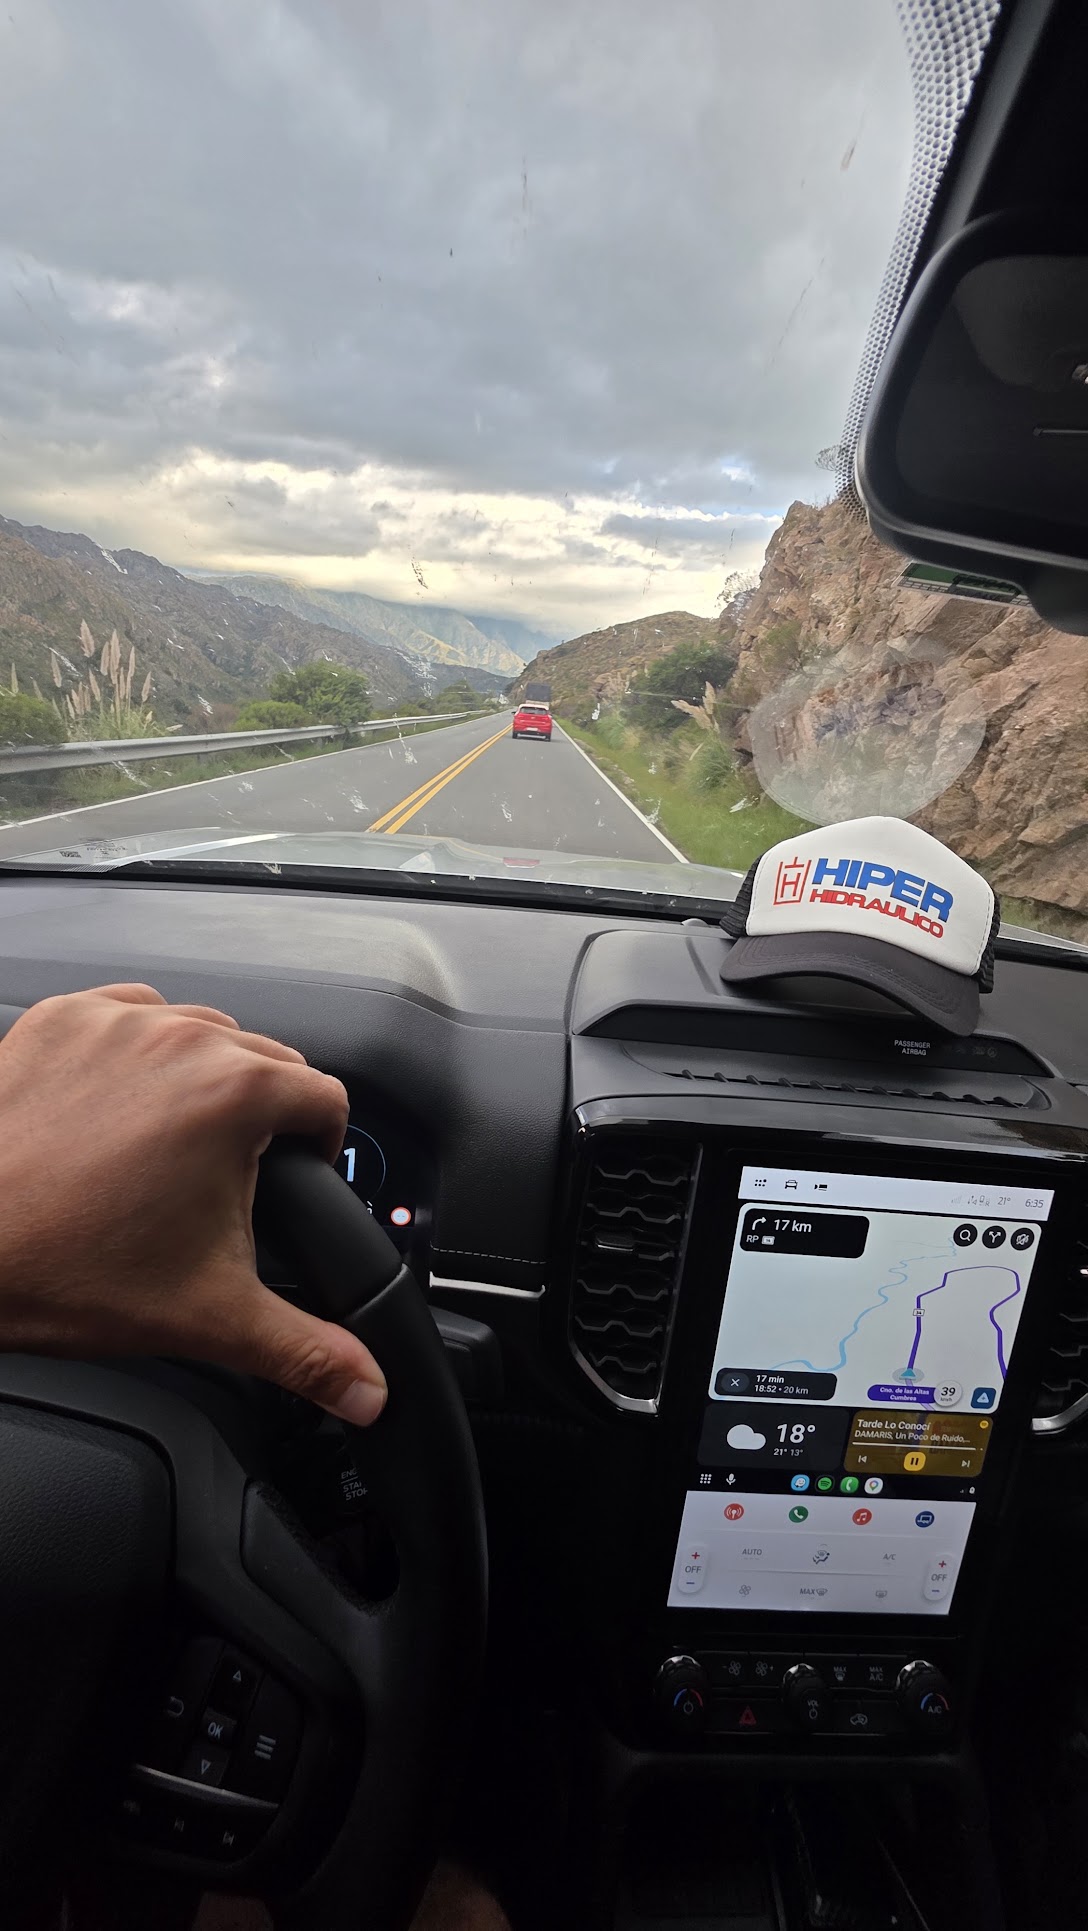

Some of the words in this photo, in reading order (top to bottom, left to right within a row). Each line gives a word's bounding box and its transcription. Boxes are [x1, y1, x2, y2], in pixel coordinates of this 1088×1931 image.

[811, 857, 954, 923] HIPER
[809, 888, 944, 939] HIDRAULICO
[894, 1040, 931, 1049] PASSENGER
[901, 1048, 927, 1056] AIRBAG
[1025, 1198, 1044, 1209] 6:35
[774, 1219, 790, 1231] 17
[791, 1219, 812, 1233] km
[746, 1234, 759, 1243] RP
[756, 1374, 767, 1383] 17
[768, 1375, 785, 1384] min
[754, 1384, 777, 1393] 18:52
[783, 1386, 794, 1394] 20
[795, 1386, 809, 1395] km
[904, 1387, 913, 1395] las
[913, 1388, 930, 1396] Altas
[940, 1386, 956, 1397] 39
[858, 1419, 883, 1429] Tarde
[884, 1420, 897, 1430] Lo
[898, 1421, 932, 1431] Conocí
[777, 1423, 816, 1444] 18°
[854, 1430, 894, 1440] DAMARIS,
[895, 1431, 907, 1440] Un
[907, 1432, 929, 1441] Poco
[930, 1433, 940, 1441] de
[773, 1448, 788, 1456] 21°
[790, 1449, 803, 1457] 13°
[741, 1548, 763, 1556] AUTO
[882, 1553, 897, 1561] A/C
[684, 1565, 702, 1574] OFF
[931, 1573, 947, 1582] OFF
[799, 1587, 816, 1596] MAX
[869, 1666, 884, 1674] MAX
[869, 1673, 884, 1682] A/C
[927, 1705, 943, 1714] A/C
[207, 1722, 224, 1739] OK
